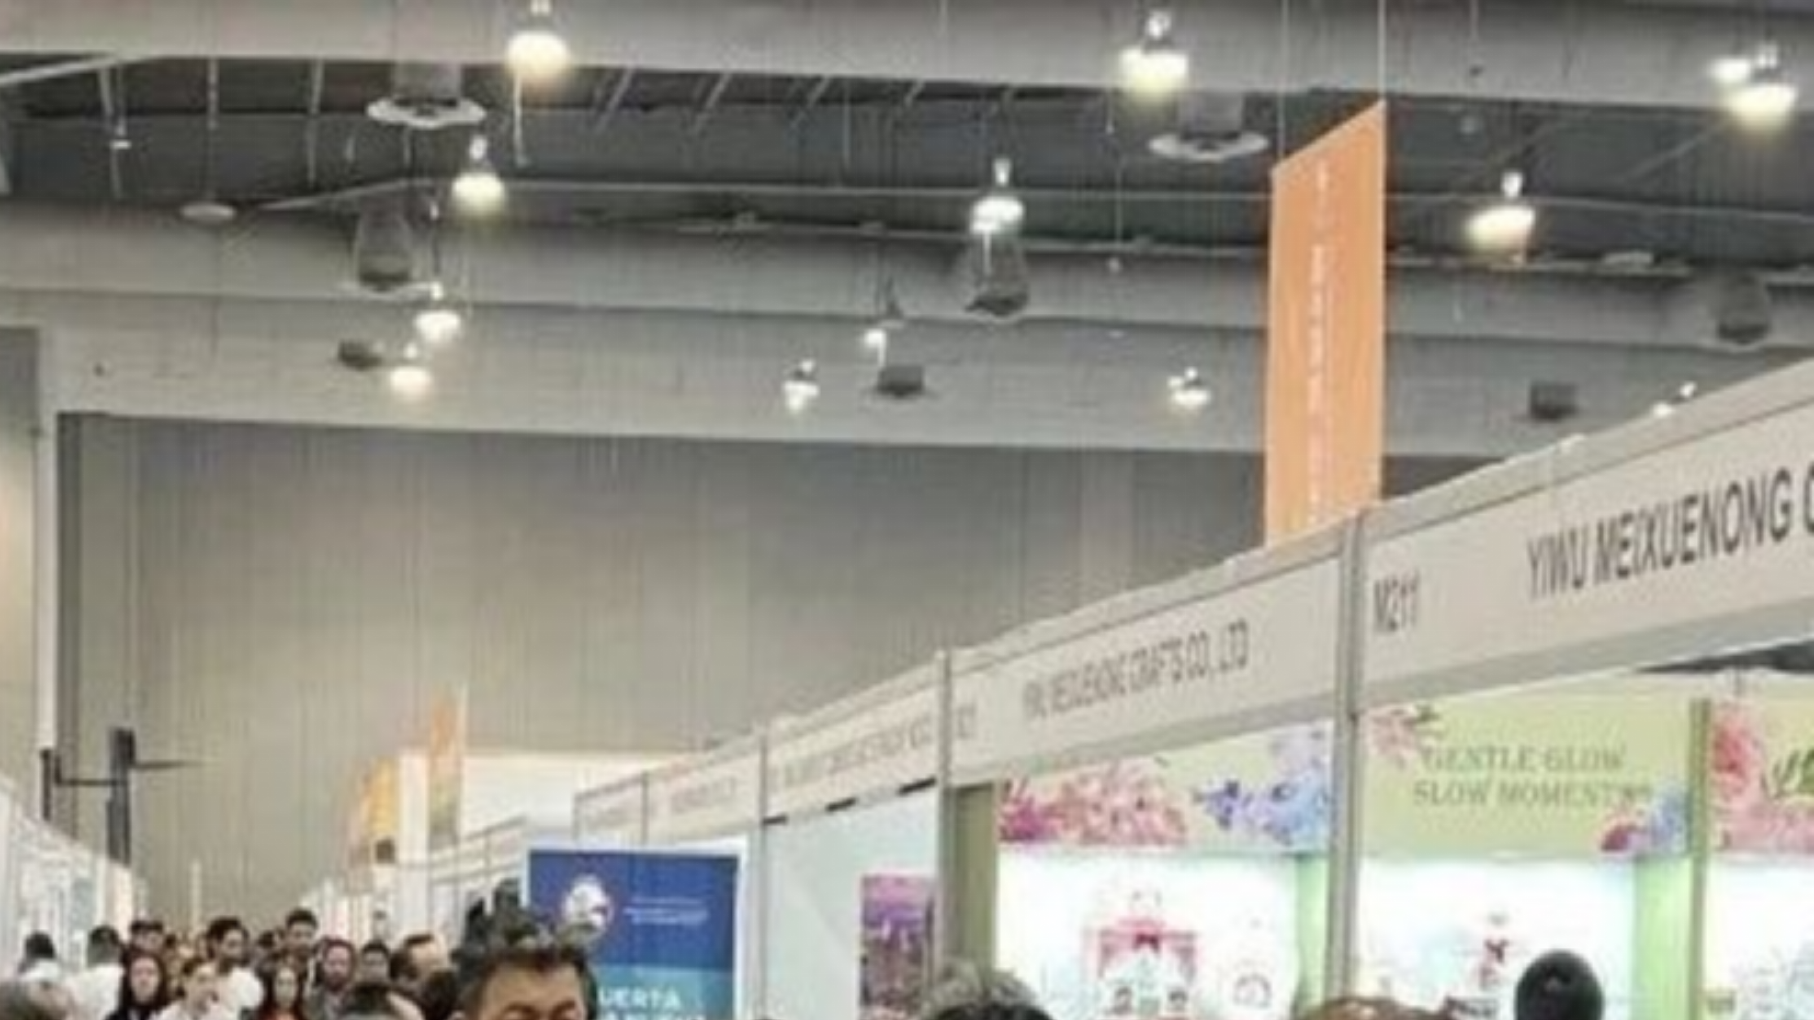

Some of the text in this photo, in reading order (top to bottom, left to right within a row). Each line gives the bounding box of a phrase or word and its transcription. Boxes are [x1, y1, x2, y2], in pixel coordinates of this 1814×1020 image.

[1528, 525, 1589, 602] YIWU
[1593, 468, 1793, 585] MEIXUENONG
[1412, 777, 1493, 808] SLOW
[598, 985, 681, 1009] UERTA
